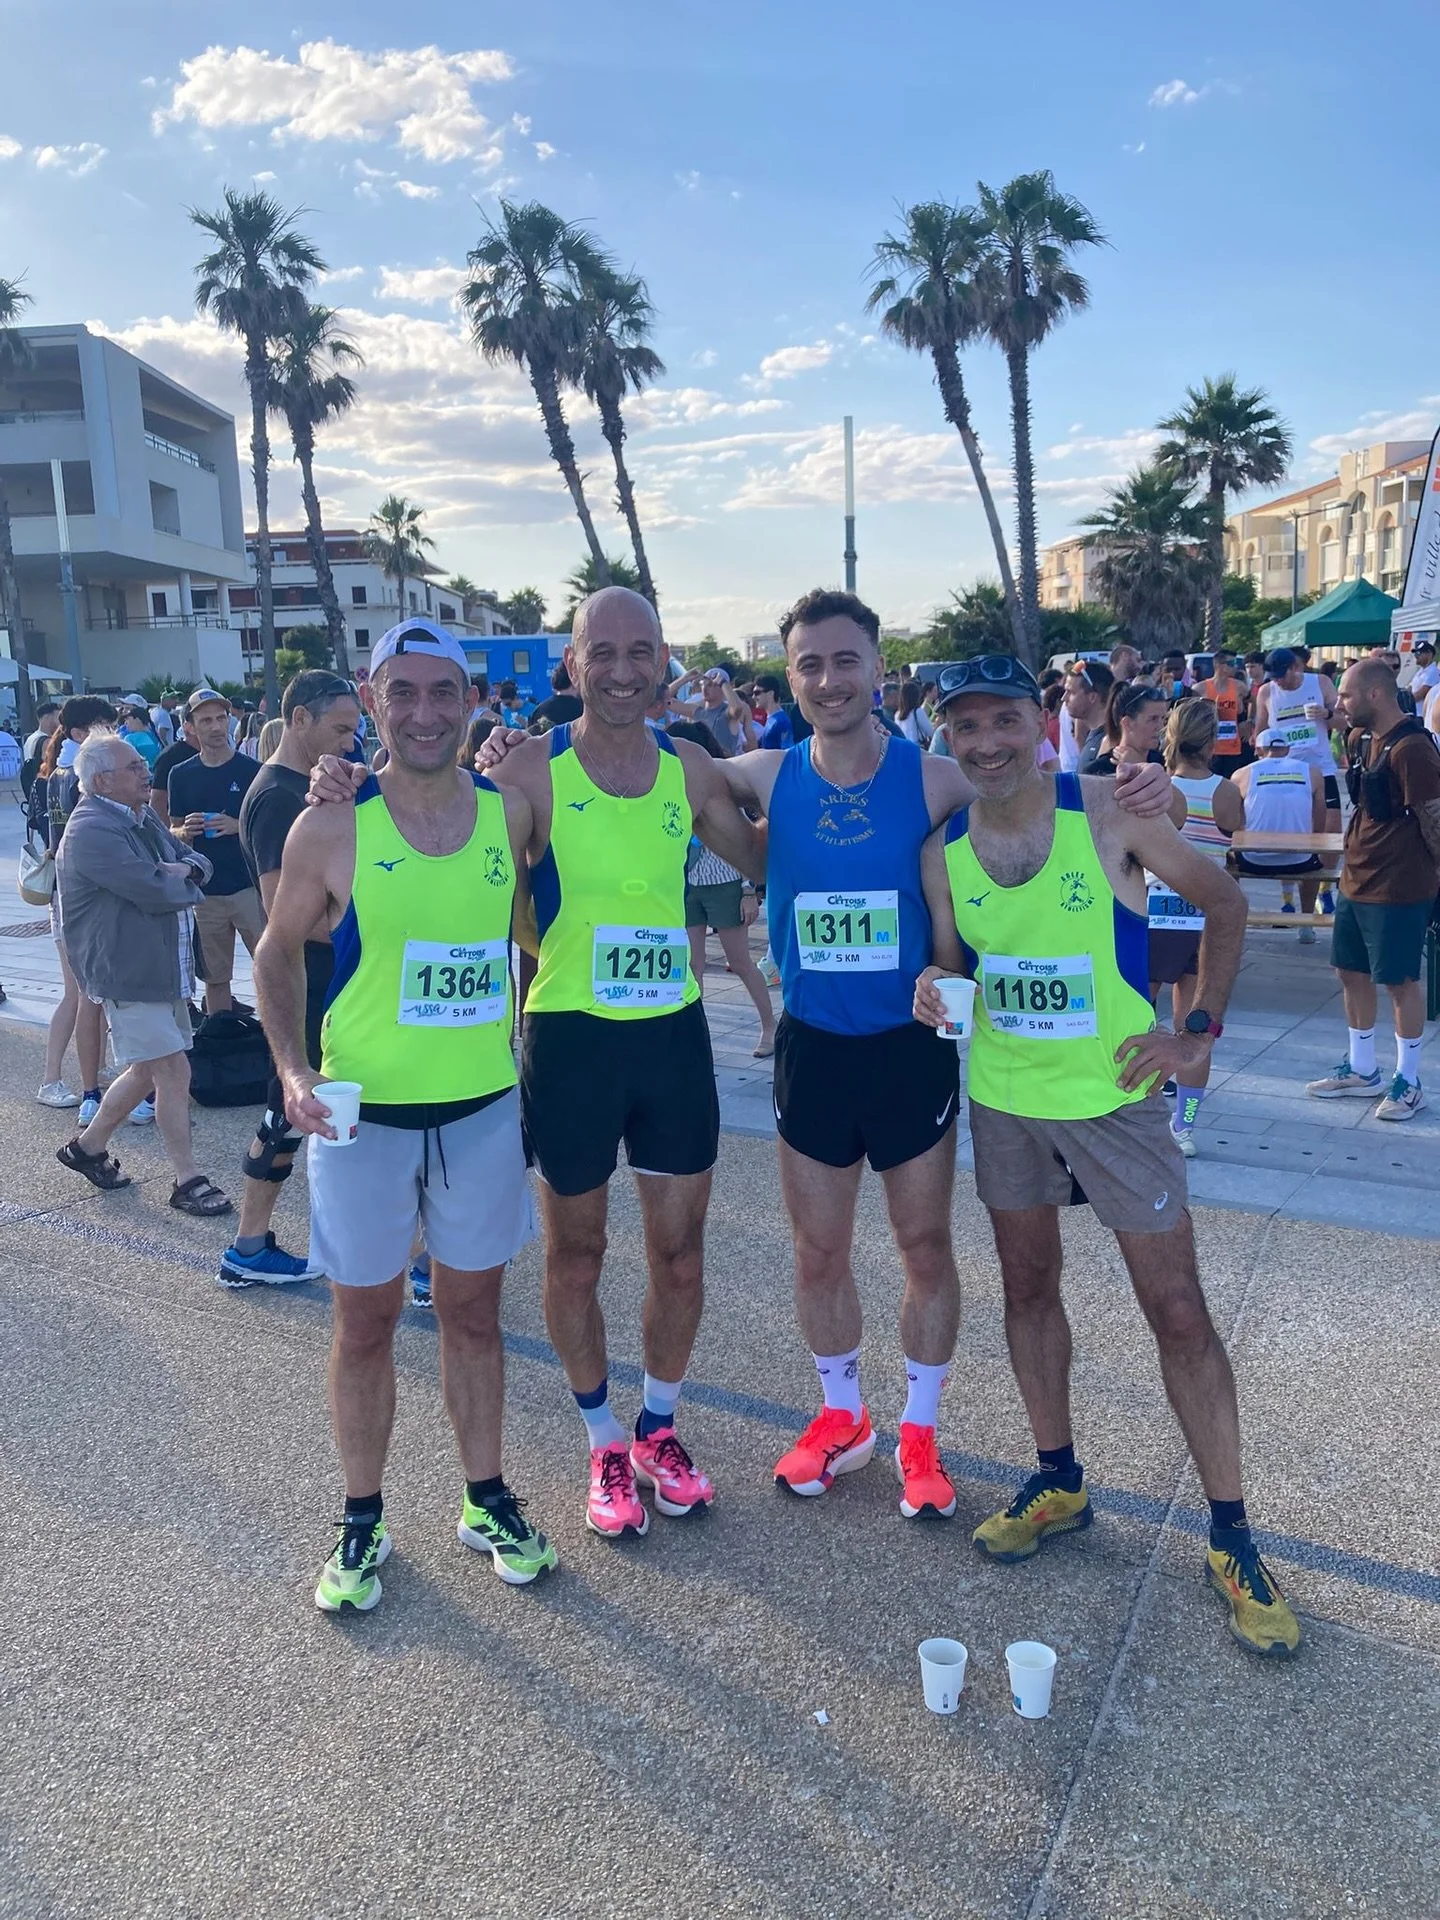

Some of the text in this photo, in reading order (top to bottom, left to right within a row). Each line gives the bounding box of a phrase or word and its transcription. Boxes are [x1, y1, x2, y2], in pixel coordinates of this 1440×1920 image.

[820, 794, 868, 807] ARLES
[805, 912, 889, 944] 1311 M
[606, 947, 681, 979] 1219 M
[836, 954, 842, 962] 5
[845, 954, 860, 962] KM
[417, 963, 491, 999] 1364
[638, 989, 644, 998] 5
[645, 989, 658, 998] KM
[994, 977, 1085, 1011] 1189 M
[453, 1008, 460, 1017] 5
[462, 1007, 476, 1016] KM
[1028, 1020, 1036, 1029] 5
[1038, 1021, 1054, 1030] KM
[1184, 1097, 1199, 1123] GOING
